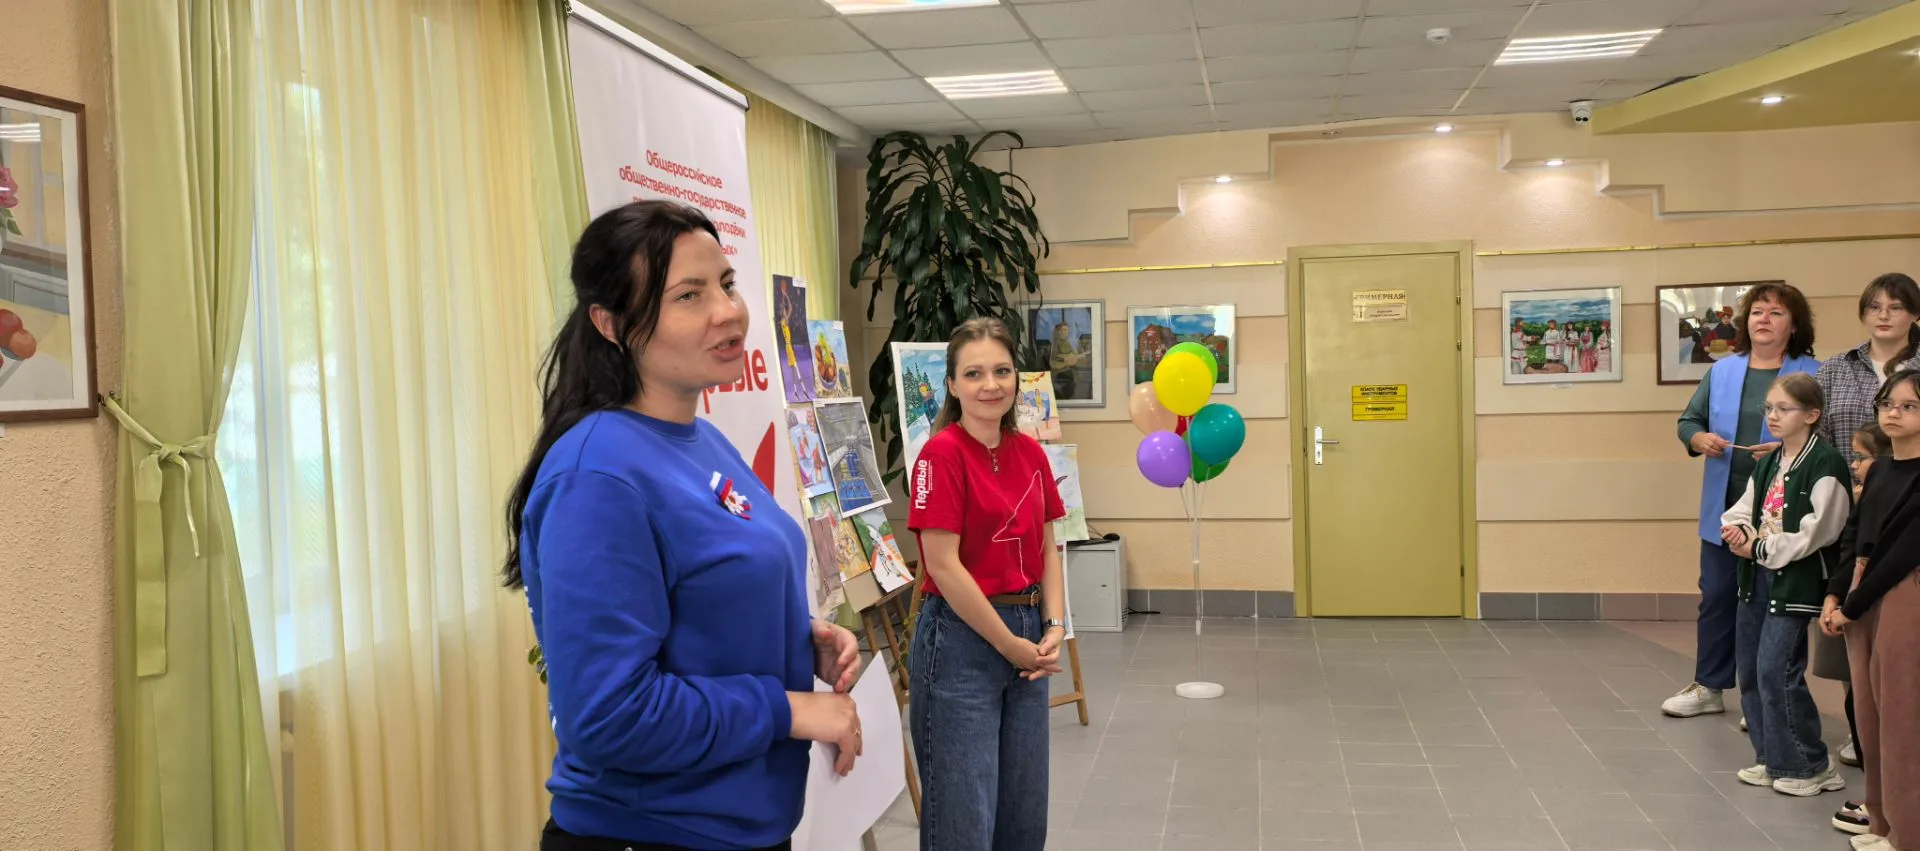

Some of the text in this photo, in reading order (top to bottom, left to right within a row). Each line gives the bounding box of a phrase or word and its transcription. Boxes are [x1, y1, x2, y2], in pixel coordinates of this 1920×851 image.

[645, 149, 723, 189] Общероссийское
[618, 165, 747, 219] общественно-государственное
[713, 220, 746, 239] олодёжи
[915, 459, 930, 510] Первые
